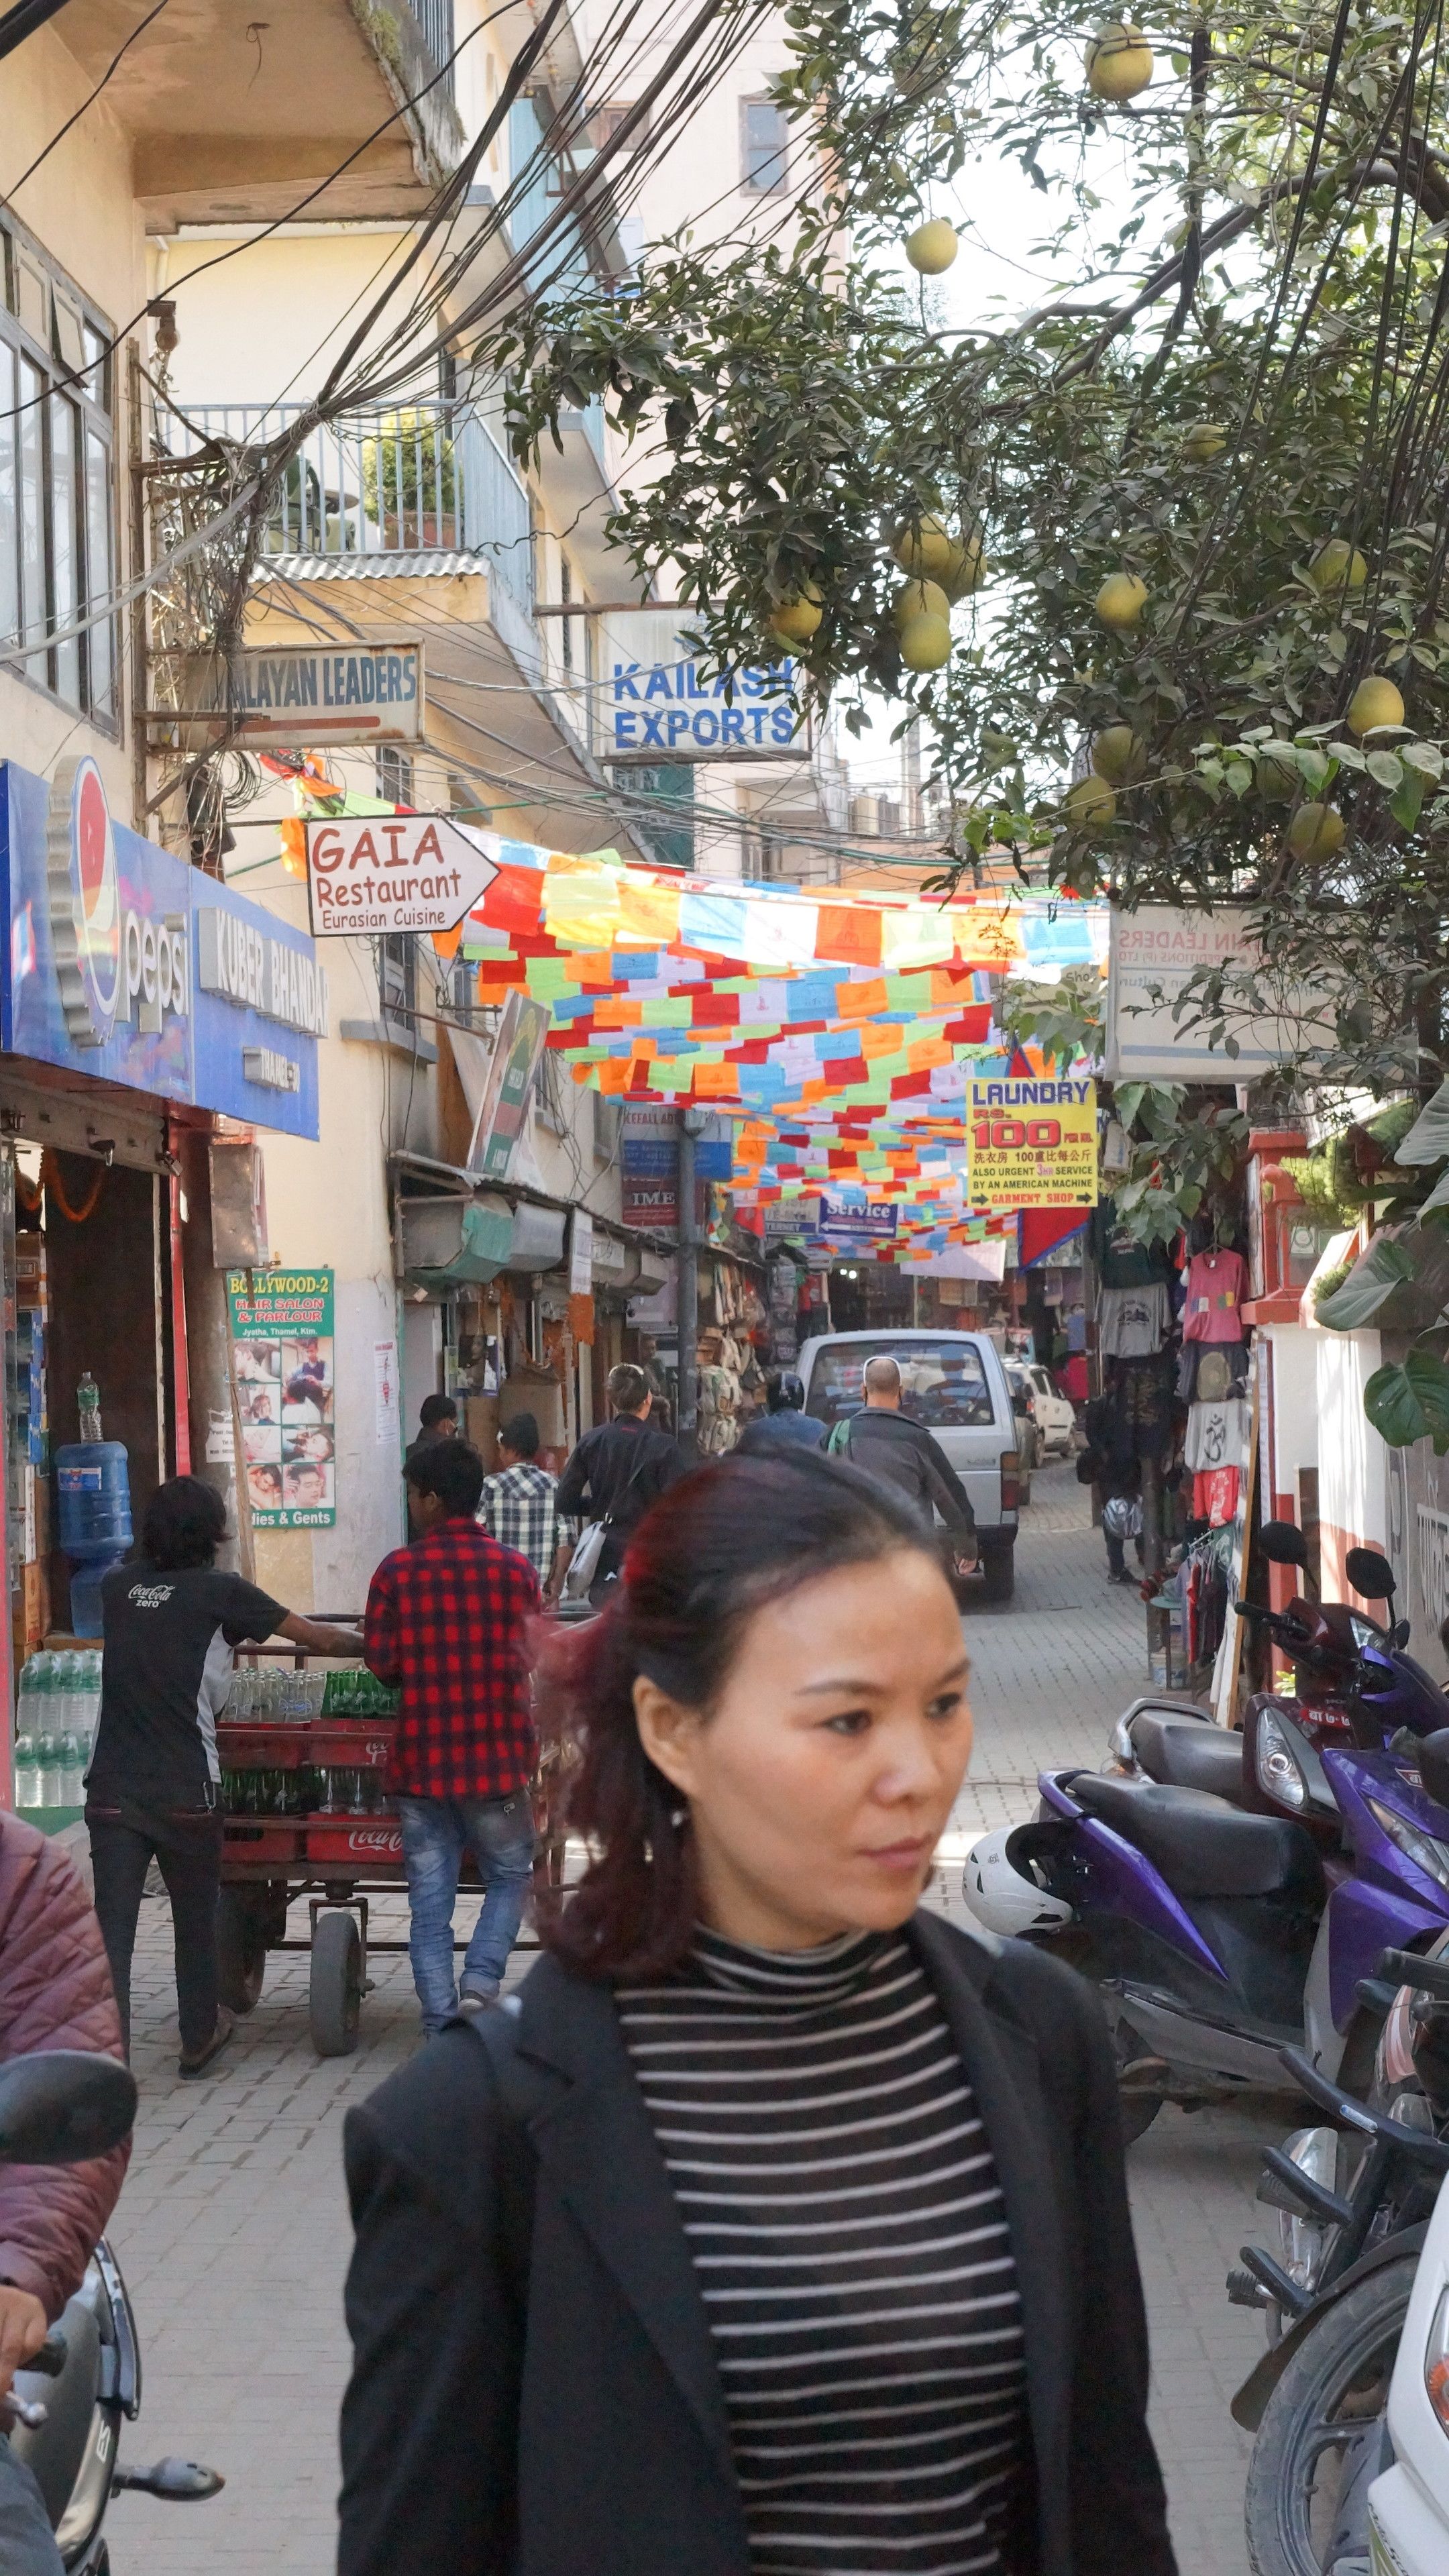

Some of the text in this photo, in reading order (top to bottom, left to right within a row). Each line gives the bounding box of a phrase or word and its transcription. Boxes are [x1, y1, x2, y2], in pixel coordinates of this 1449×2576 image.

[323, 655, 416, 704] LEADERS
[615, 707, 794, 749] EXPORTS
[313, 823, 444, 873] GAIA
[317, 868, 462, 908] Restaurant
[323, 907, 445, 929] Eurasian Cuisine
[125, 909, 189, 1034] pepsi
[216, 907, 329, 1038] KUBER BHANDAR
[973, 1081, 1089, 1106] LAUNDRY
[973, 1108, 1012, 1119] RS.
[971, 1119, 1061, 1149] 100
[974, 1151, 1008, 1164] 洗衣房
[973, 1168, 996, 1176] ALSO
[998, 1167, 1034, 1175] URGENT
[1056, 1166, 1093, 1175] SERVICE
[973, 1179, 1092, 1189] BY AN AMERICAN MACHINE
[633, 1191, 675, 1205] IME
[991, 1193, 1074, 1203] GARMENT SHOP
[827, 1203, 891, 1218] Service
[236, 1298, 325, 1309] HIR SALON
[238, 1311, 322, 1323] & PARLOUR
[242, 1327, 317, 1336] Jyatha, Thamel, Ktm.
[279, 1511, 288, 1525] &
[292, 1511, 331, 1525] Gents
[136, 1599, 160, 1608] zero
